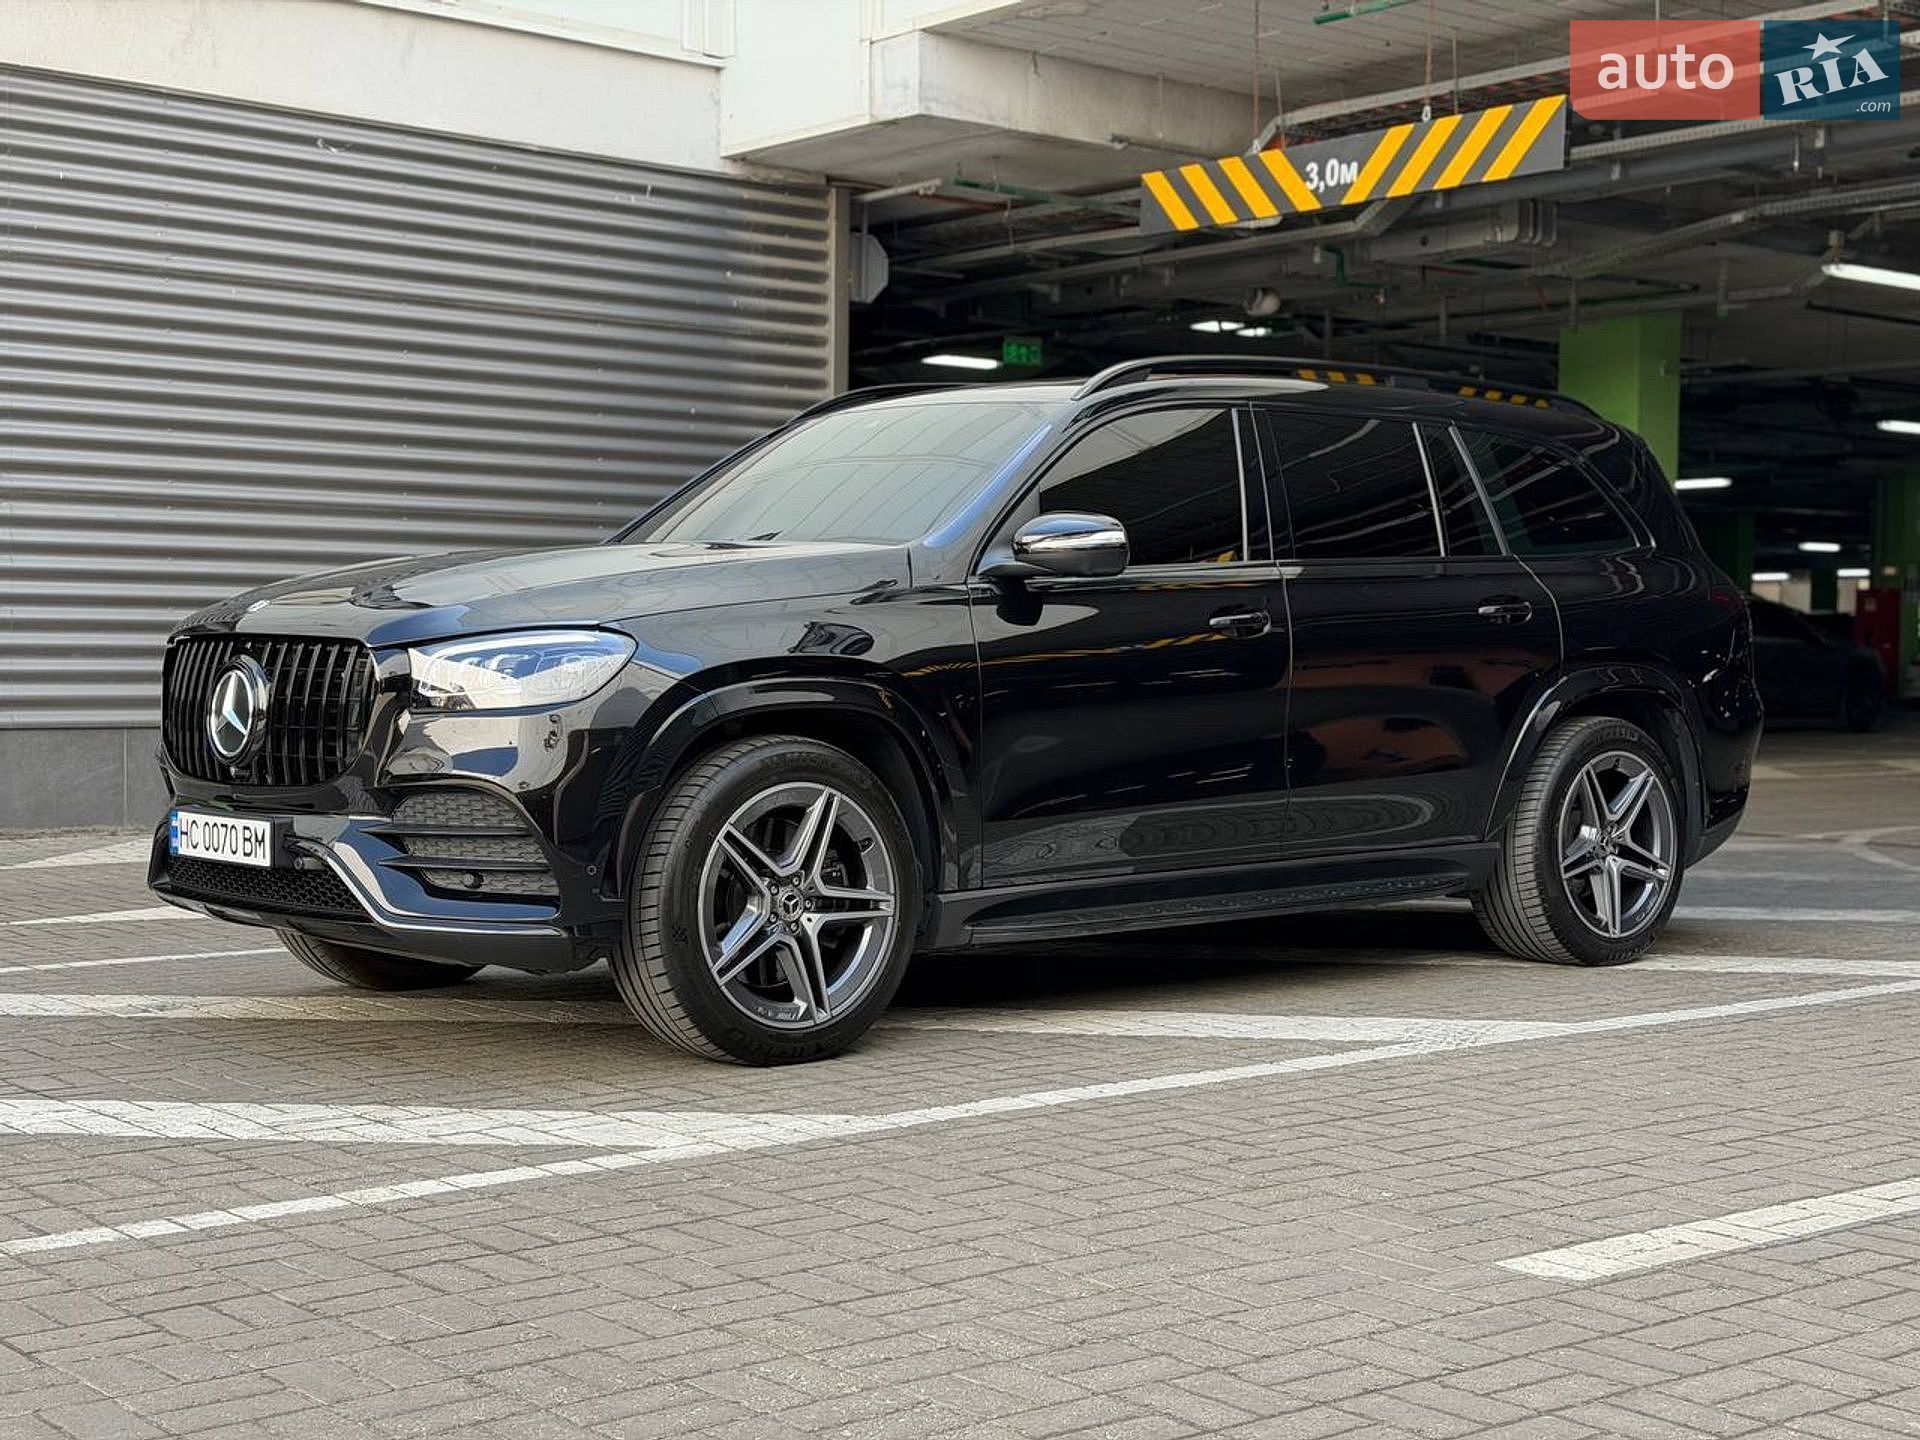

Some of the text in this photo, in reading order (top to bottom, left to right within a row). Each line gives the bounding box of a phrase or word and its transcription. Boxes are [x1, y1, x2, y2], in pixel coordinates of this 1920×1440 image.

[180, 817, 266, 859] HC 0070 BM
